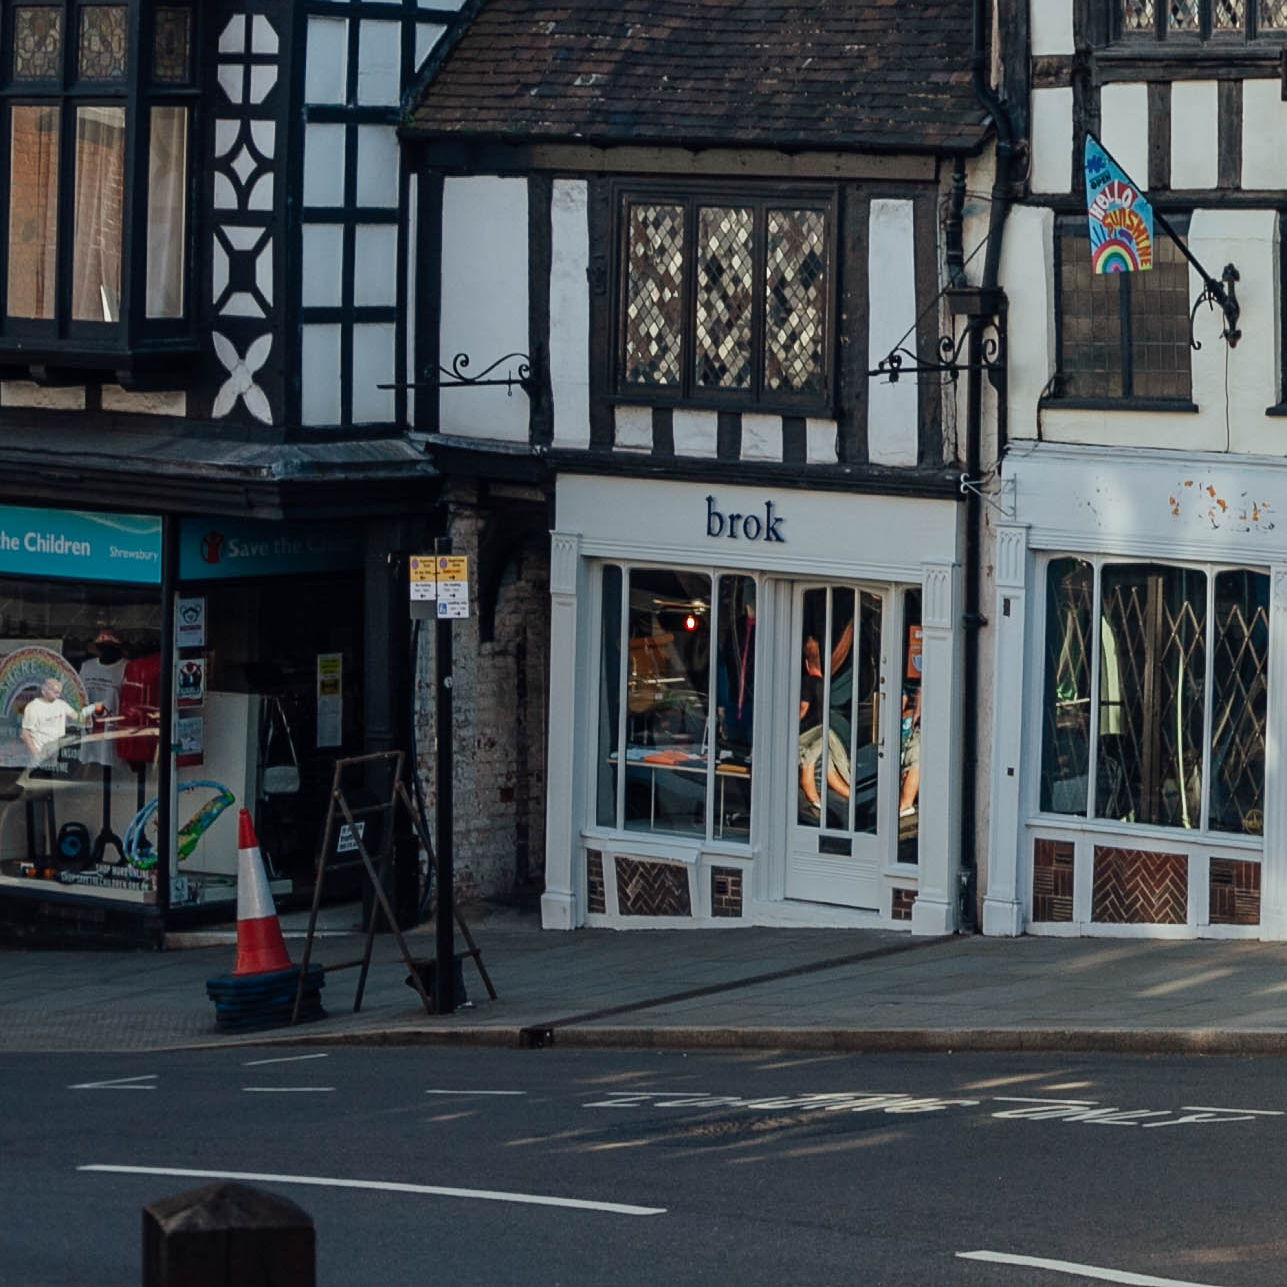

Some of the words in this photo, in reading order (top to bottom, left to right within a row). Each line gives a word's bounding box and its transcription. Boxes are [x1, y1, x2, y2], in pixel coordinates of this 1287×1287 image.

[705, 494, 786, 543] brok
[0, 528, 20, 551] he
[24, 531, 91, 557] Children
[109, 545, 159, 563] Shrewsbury
[228, 536, 268, 559] Save
